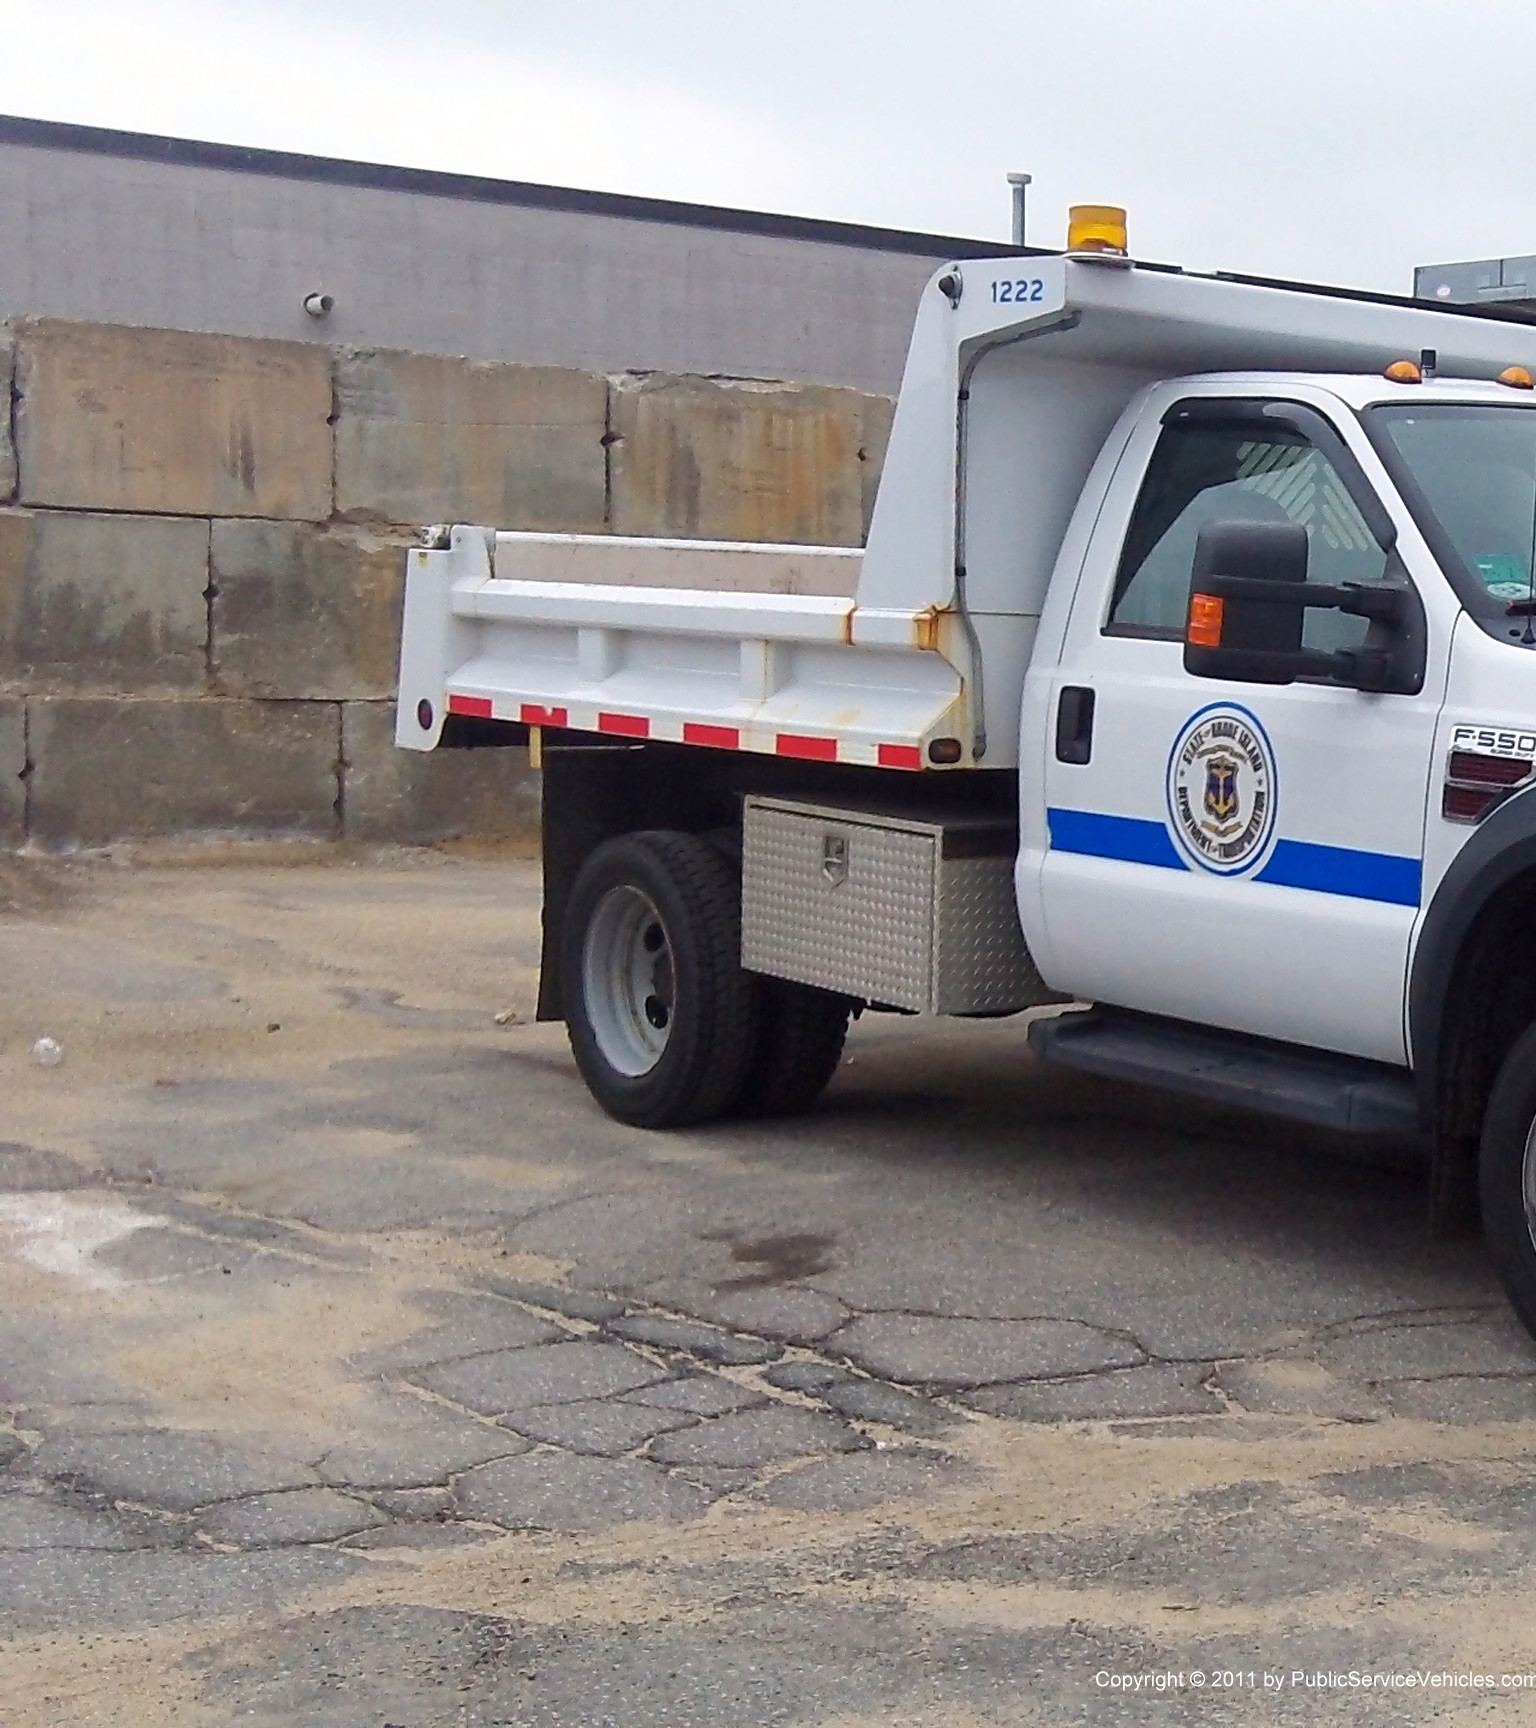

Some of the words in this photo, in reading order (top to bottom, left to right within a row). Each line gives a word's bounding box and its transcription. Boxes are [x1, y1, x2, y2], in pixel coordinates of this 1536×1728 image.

[991, 279, 1043, 303] 1222
[1182, 730, 1205, 765] STATE
[1238, 729, 1262, 773] ISLAND
